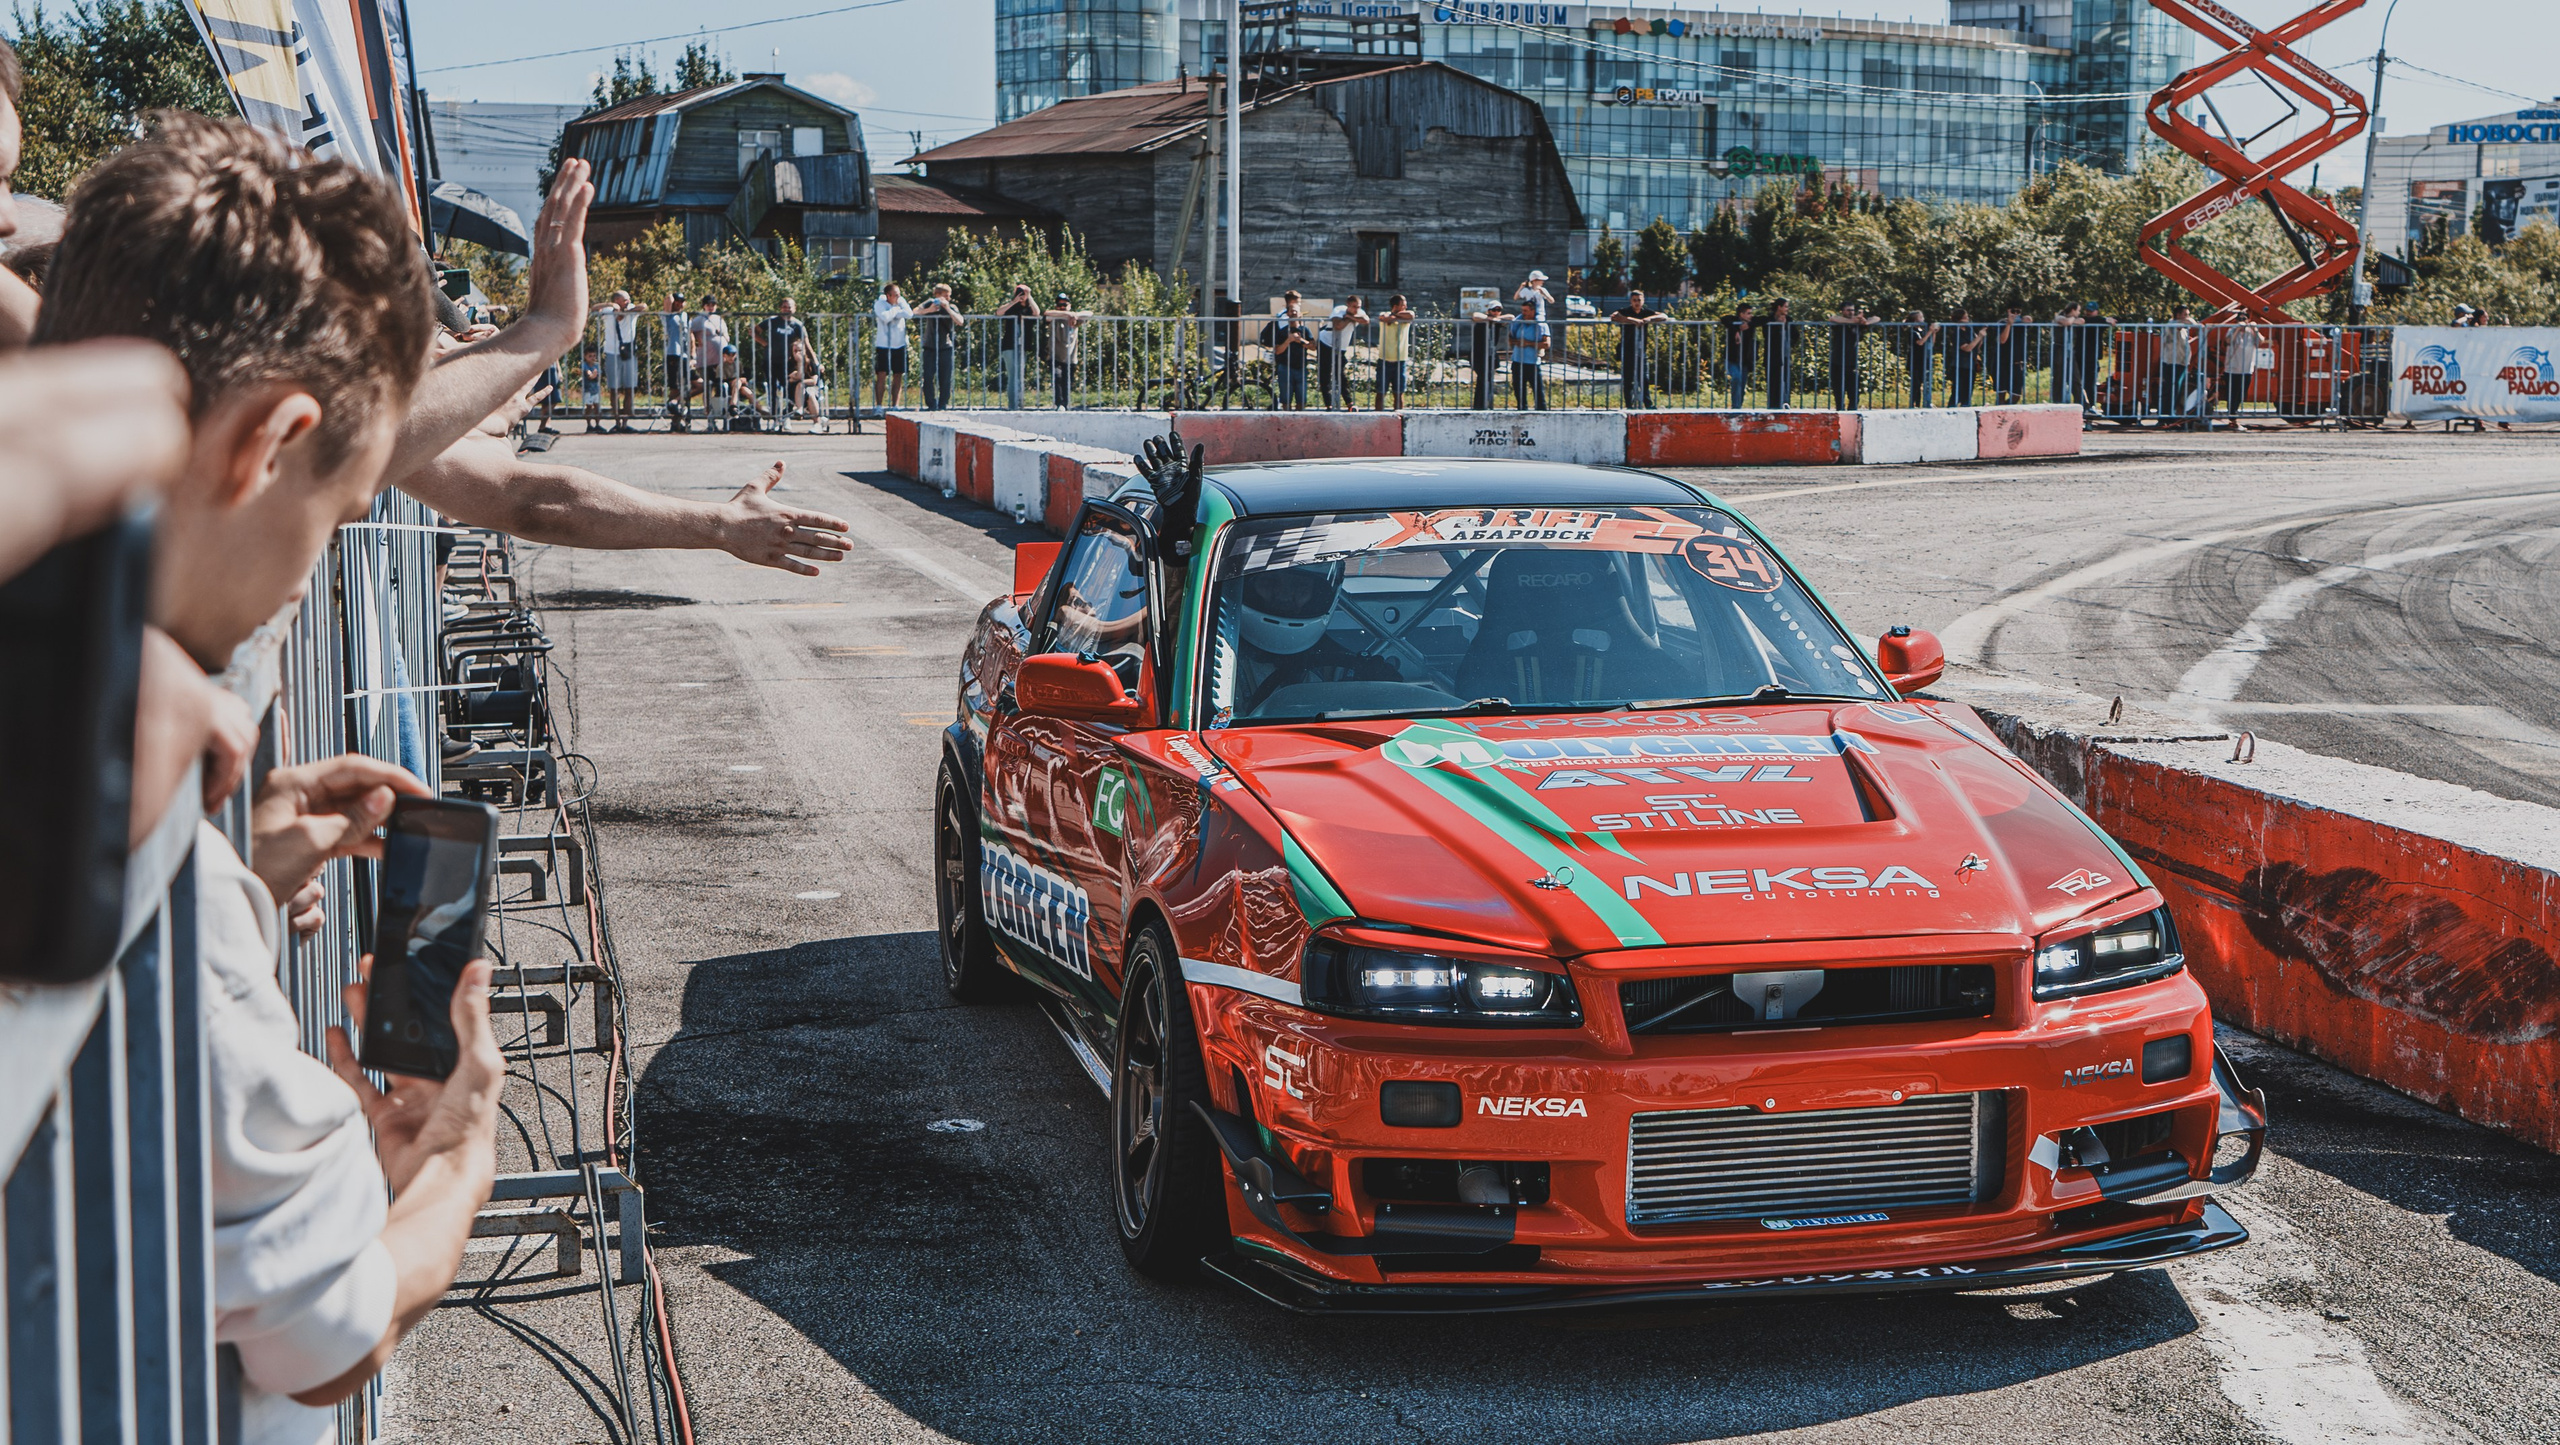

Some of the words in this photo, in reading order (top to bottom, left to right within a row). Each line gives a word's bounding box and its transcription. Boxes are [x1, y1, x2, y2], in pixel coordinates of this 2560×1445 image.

[1782, 26, 1823, 45] мир
[1635, 88, 1655, 100] РБ
[1657, 89, 1704, 102] ГРУПП
[1760, 153, 1823, 174] SATA
[2184, 186, 2251, 231] СЕРВИС
[2399, 366, 2443, 380] АВТО
[2495, 367, 2537, 380] АВТО
[2412, 380, 2467, 395] РАДИО
[2509, 380, 2560, 395] РАДИО
[1693, 542, 1773, 583] 34
[1518, 572, 1594, 587] RECARO
[1395, 735, 1880, 767] MOLYGREEN
[1500, 760, 1552, 769] SUPER
[1553, 759, 1597, 767] HIGH
[1602, 757, 1725, 765] PERFORMANCE
[1623, 866, 1939, 900] NEKSA
[1742, 888, 1940, 900] autotuning
[2061, 1058, 2134, 1088] NEKSA
[1478, 1096, 1588, 1117] NEKSA
[1763, 1212, 1890, 1230] MOLYGREEN
